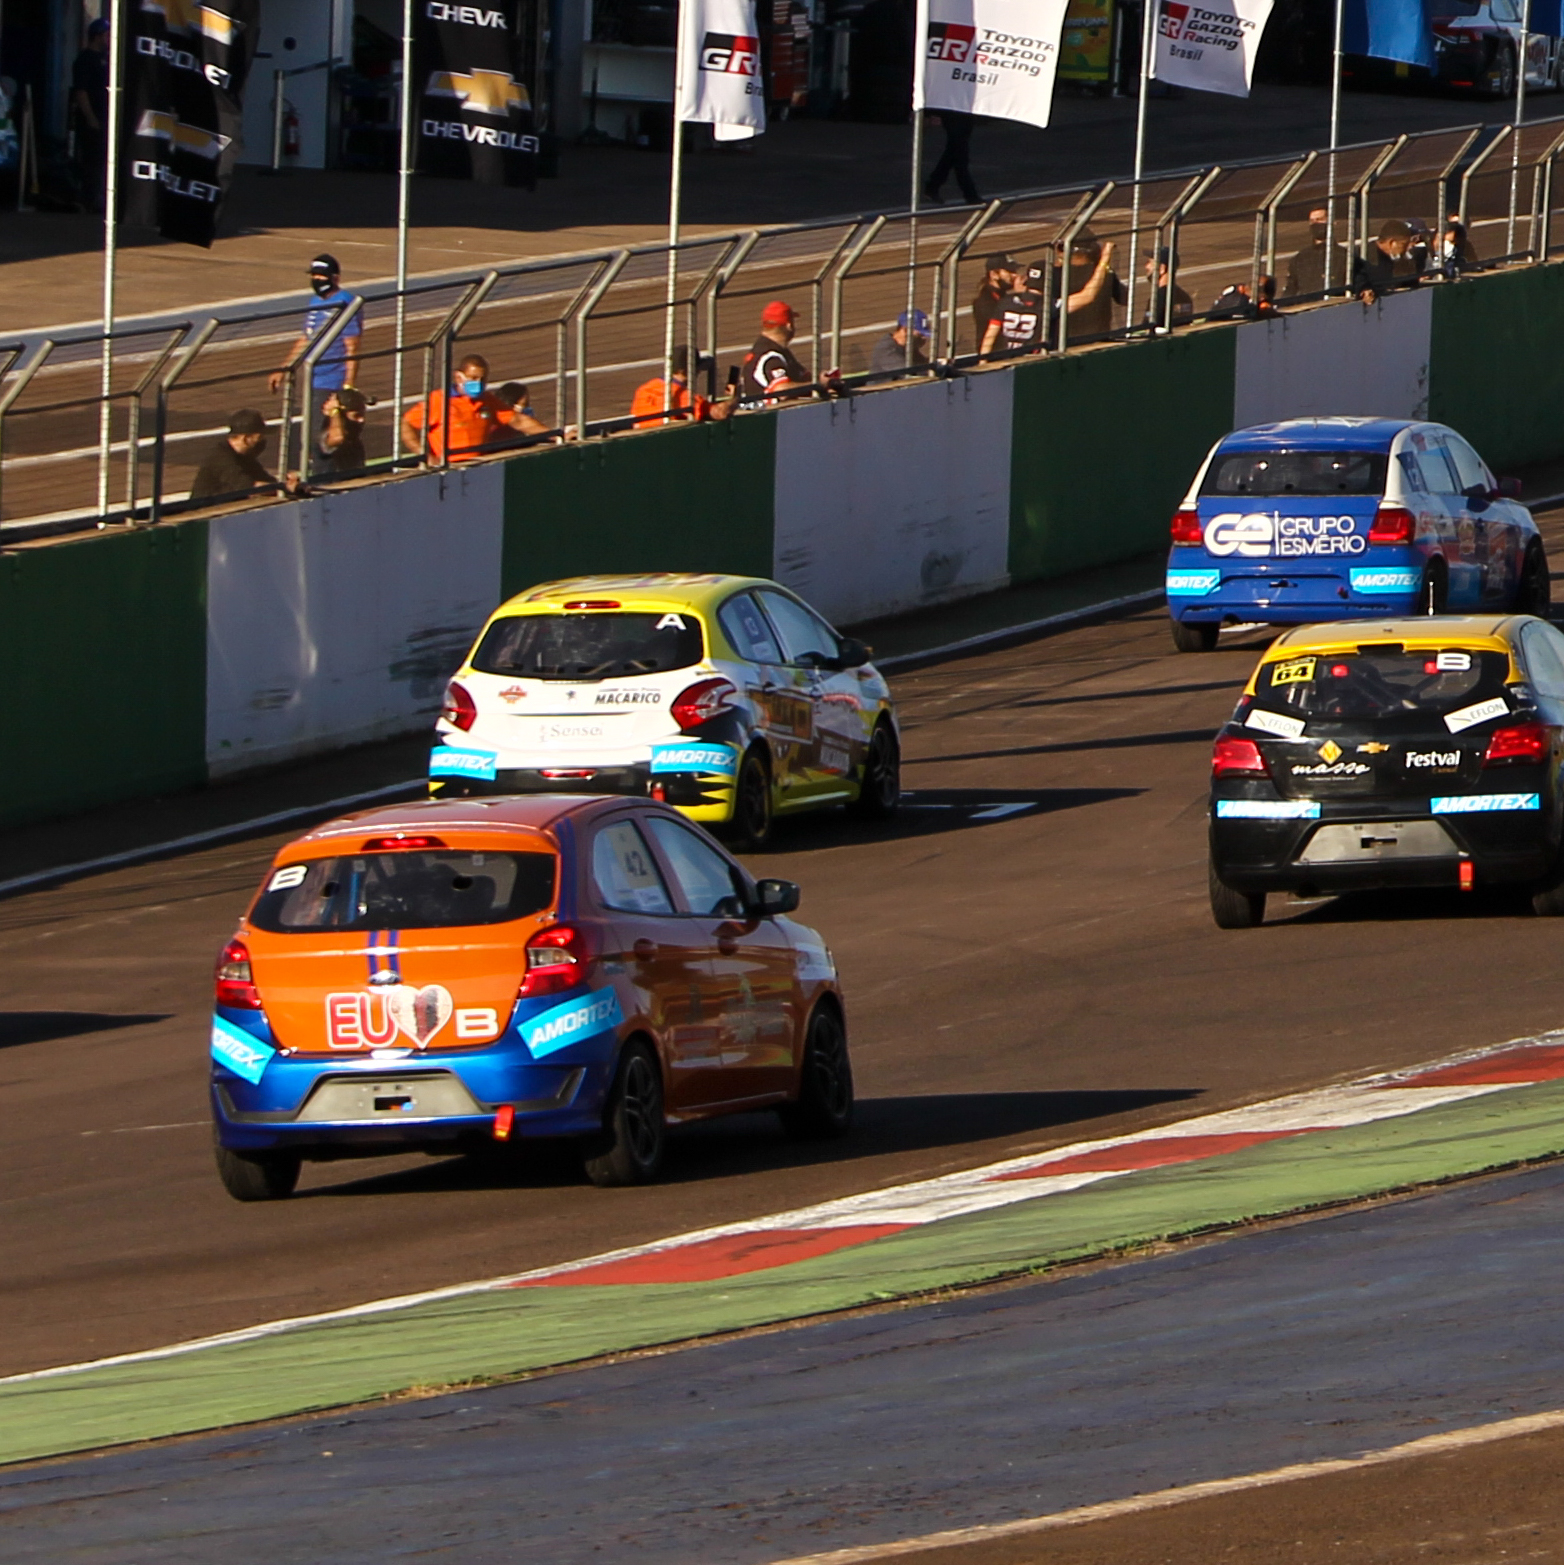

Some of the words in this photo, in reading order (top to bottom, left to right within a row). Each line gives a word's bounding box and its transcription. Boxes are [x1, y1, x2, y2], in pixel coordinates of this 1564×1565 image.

[1187, 19, 1246, 38] GAZOO
[1192, 7, 1256, 31] TOYOTA
[928, 36, 971, 64] GR
[981, 28, 1056, 53] TOYOTA
[1182, 30, 1240, 51] Racing
[701, 47, 756, 73] GR
[976, 41, 1048, 63] GAZOO
[973, 52, 1042, 78] Racing
[951, 67, 1000, 87] Brasil
[422, 118, 540, 154] CHEVROLET
[1279, 515, 1356, 535] GRUPO
[655, 613, 687, 631] A
[1436, 652, 1472, 672] B
[1274, 664, 1311, 683] 64
[652, 748, 737, 769] AMORTEX
[1405, 749, 1461, 768] Festval
[1430, 793, 1532, 813] AMORTEX
[266, 865, 309, 893] B
[325, 990, 397, 1050] EU
[455, 1007, 500, 1039] B
[529, 997, 619, 1046] AMORTEX
